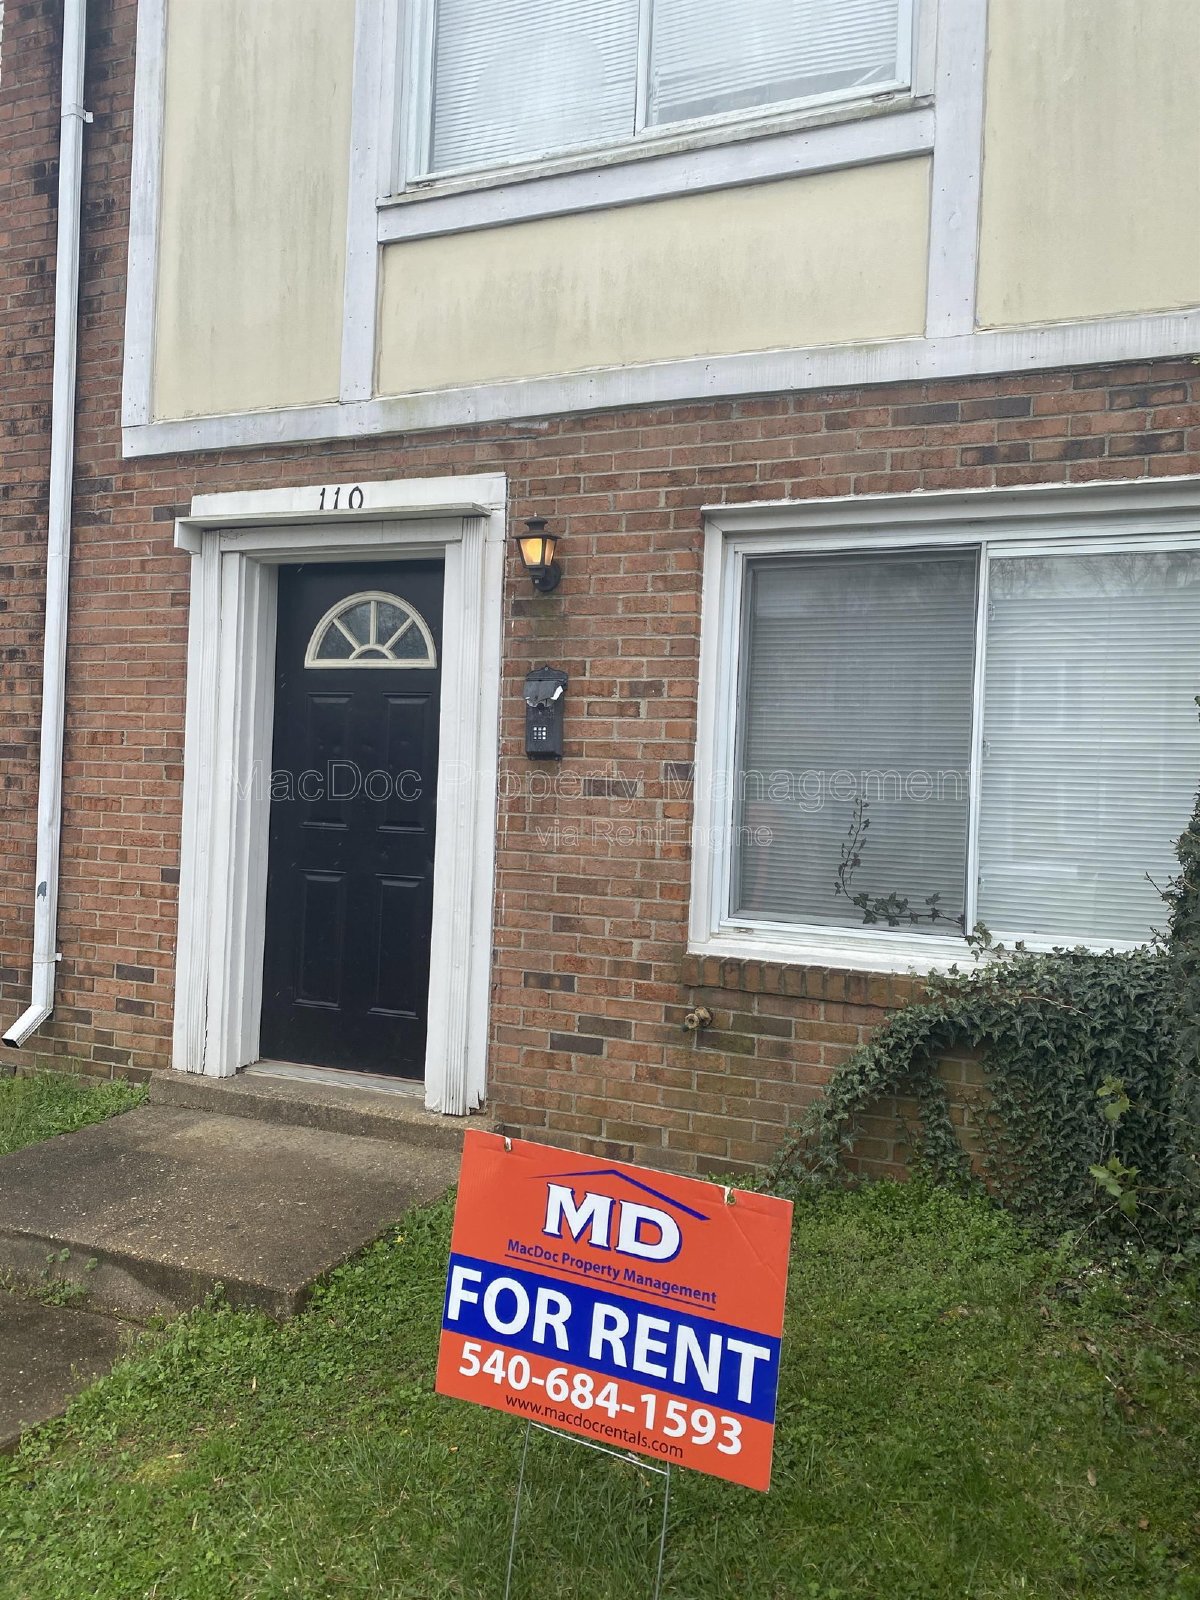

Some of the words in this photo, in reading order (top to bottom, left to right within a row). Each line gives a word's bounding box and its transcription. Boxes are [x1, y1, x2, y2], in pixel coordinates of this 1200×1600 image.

[320, 486, 364, 510] 110
[542, 1182, 682, 1263] MD
[507, 1239, 559, 1263] MacDoc
[562, 1253, 620, 1281] Property
[623, 1268, 717, 1304] Management
[447, 1265, 573, 1351] FOR
[589, 1302, 771, 1404] RENT
[459, 1341, 743, 1455] 540-684-1593
[505, 1394, 684, 1459] www.macdocrentals.com
